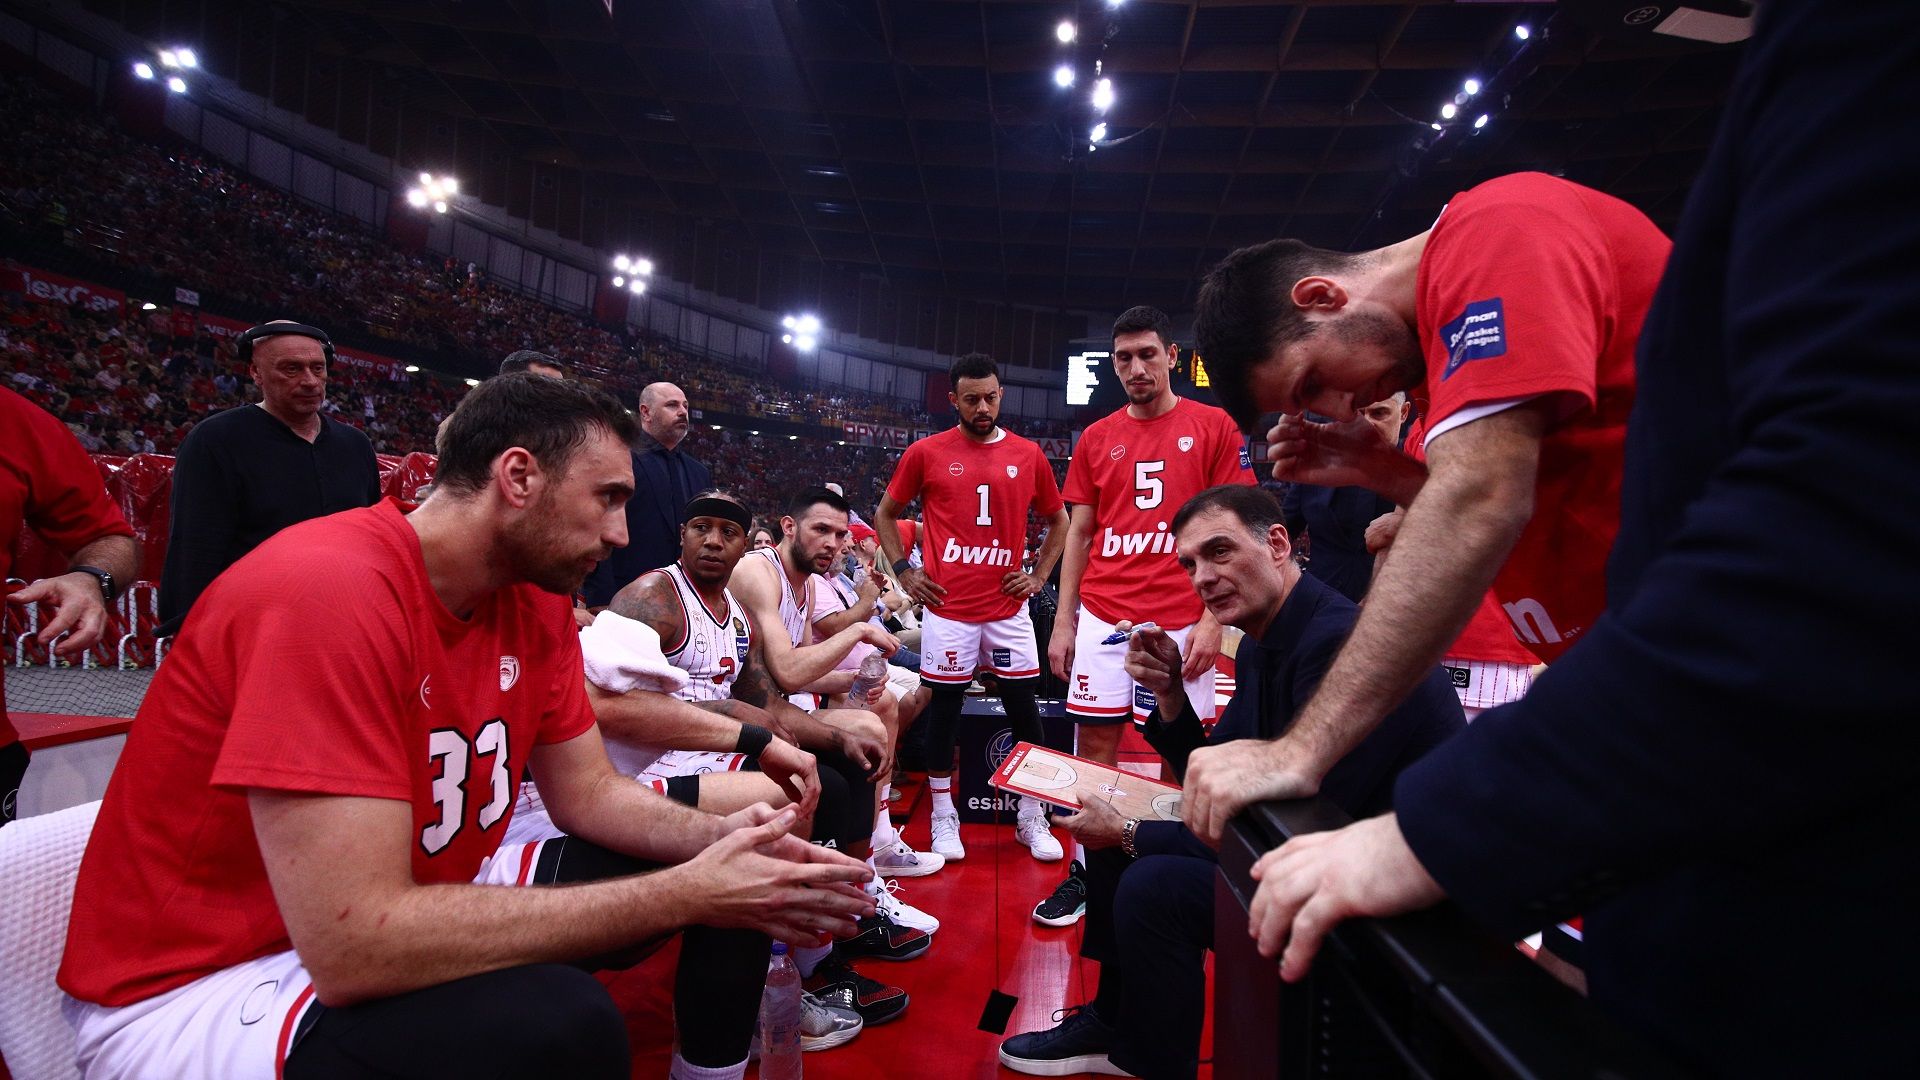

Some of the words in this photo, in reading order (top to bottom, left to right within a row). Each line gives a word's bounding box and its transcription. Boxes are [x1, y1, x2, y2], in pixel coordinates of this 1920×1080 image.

[21, 270, 120, 312] lexCar
[976, 483, 993, 527] 1
[1135, 459, 1165, 511] 5
[941, 537, 1012, 567] bwin
[1072, 691, 1099, 702] lexCar
[420, 717, 513, 857] 33
